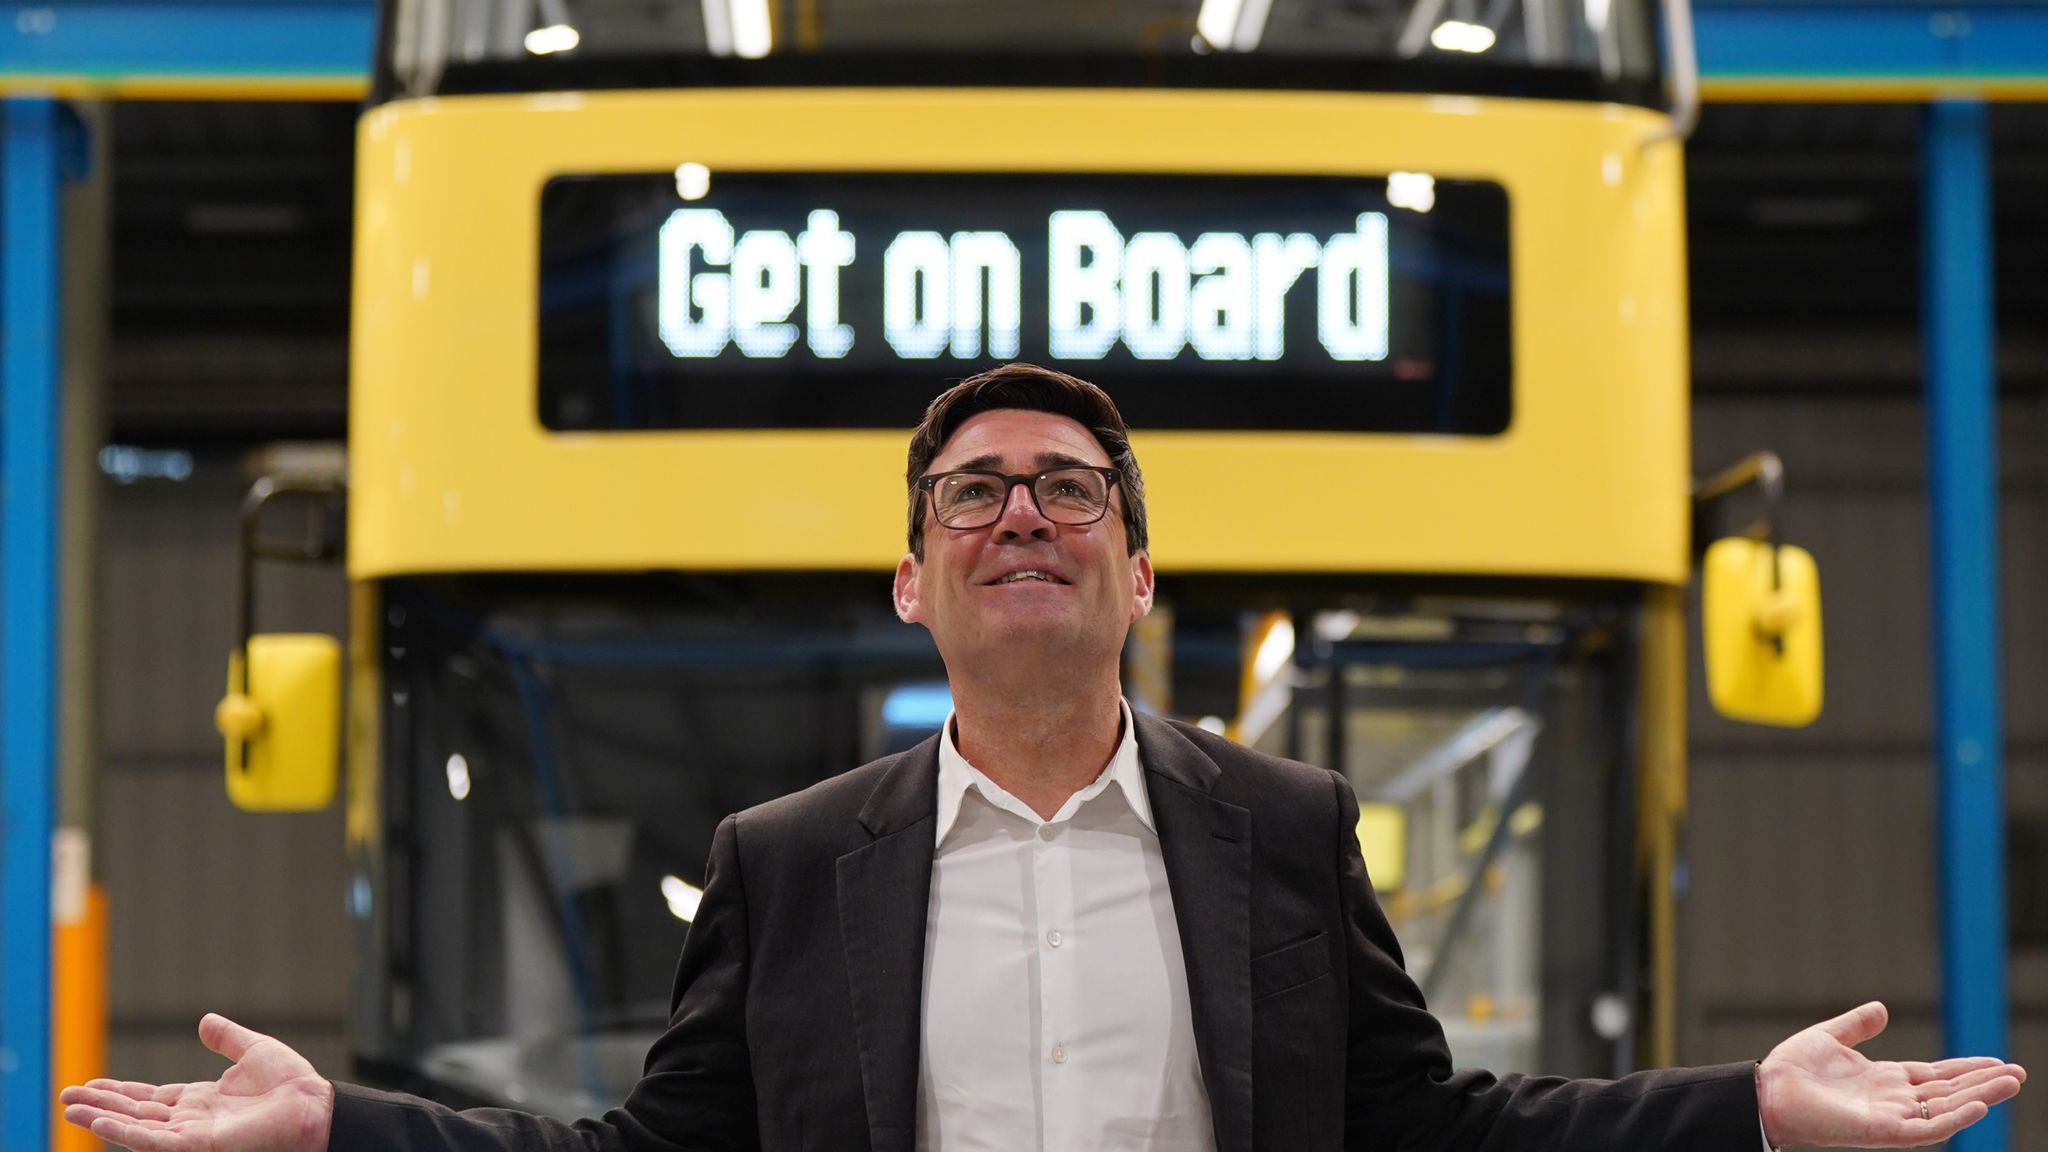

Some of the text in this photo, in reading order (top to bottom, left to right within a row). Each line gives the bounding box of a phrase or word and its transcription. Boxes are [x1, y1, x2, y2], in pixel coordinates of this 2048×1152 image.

[659, 208, 1389, 361] Get on Board
